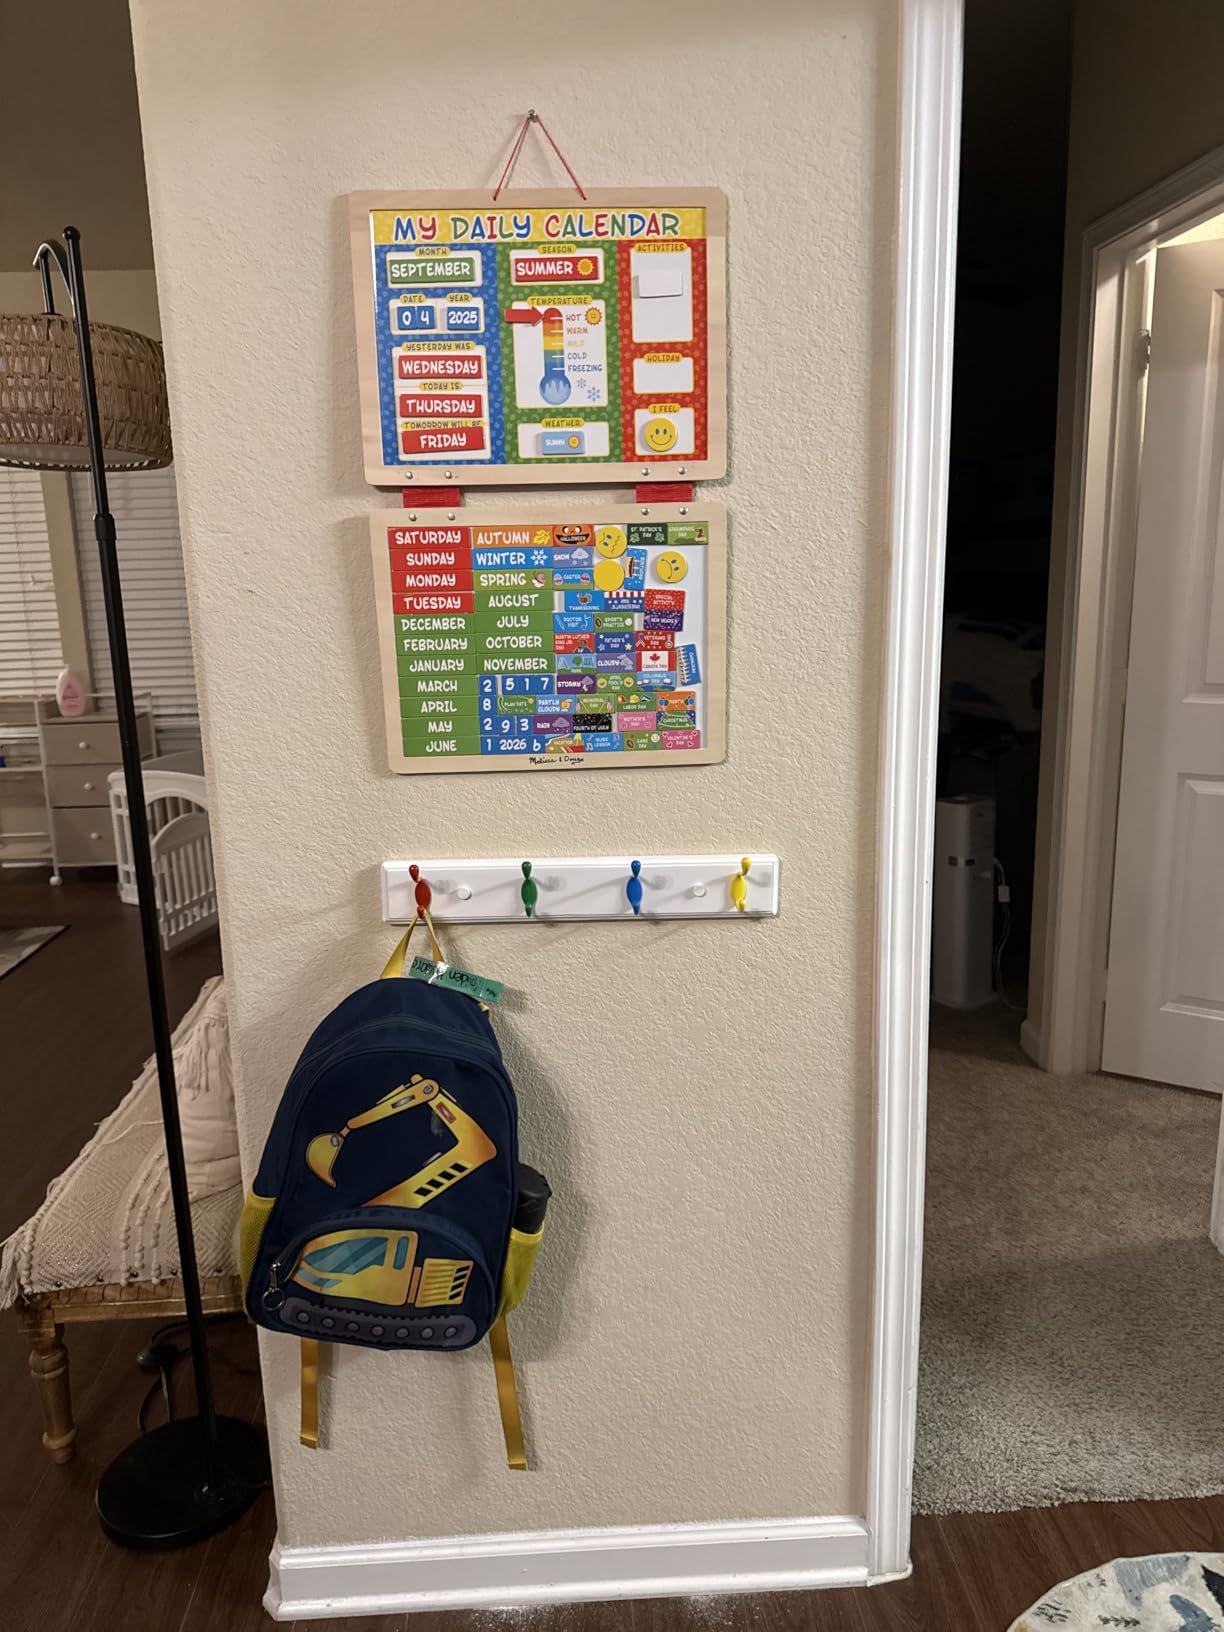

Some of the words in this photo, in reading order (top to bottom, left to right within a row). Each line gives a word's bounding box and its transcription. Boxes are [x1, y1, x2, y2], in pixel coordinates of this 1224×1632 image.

[393, 216, 437, 241] MY
[450, 215, 531, 240] DAILY
[544, 213, 680, 239] CALENDAR
[418, 247, 447, 256] MONTH
[542, 246, 572, 254] SEASON
[637, 243, 685, 252] ACTIVITIES
[391, 262, 470, 277] SEPTEMBER
[516, 261, 573, 276] SUMMER
[403, 295, 423, 303] DATE
[449, 294, 469, 302] YEAR
[530, 297, 588, 305] TEMPERATURE
[448, 311, 478, 324] 2025
[566, 313, 582, 321] HOT
[406, 343, 452, 351] YESTERDAY
[455, 342, 471, 350] WAS
[567, 352, 587, 360] COLD
[647, 354, 680, 362] HOLIDAY
[402, 360, 478, 374] WEDNESDAY
[568, 364, 603, 372] FREEZING
[451, 382, 460, 390] IS
[406, 399, 475, 413] THURSDAY
[652, 405, 657, 413] I
[659, 404, 678, 413] FEEL
[404, 421, 449, 429] TOMORROW
[544, 419, 581, 428] WEATHER
[420, 433, 467, 448] FRIDAY
[395, 531, 461, 544] SATURDAY
[477, 532, 529, 545] AUTUMN
[406, 552, 455, 566] SUNDAY
[476, 552, 526, 565] WINTER
[406, 574, 456, 587] MONDAY
[479, 573, 527, 586] SPRING
[404, 597, 461, 610] TUESDAY
[488, 594, 539, 608] AUGUST
[401, 617, 466, 631] DECEMBER
[496, 615, 529, 628] JULY
[403, 638, 468, 651] FEBRUARY
[485, 636, 542, 649] OCTOBER
[409, 659, 464, 672] JANUARY
[484, 658, 547, 671] NOVEMBER
[597, 659, 620, 667] CLOUDY
[417, 679, 458, 692] MARCH
[482, 680, 493, 693] 2
[505, 678, 515, 691] 5
[523, 678, 530, 691] 1
[540, 678, 550, 691] 7
[421, 701, 457, 713] APRIL
[482, 699, 492, 712] 8
[428, 721, 453, 733] MAY
[483, 718, 493, 731] 2
[501, 720, 511, 733] 9
[520, 718, 530, 731] 3
[425, 740, 457, 752] JUNE
[486, 739, 492, 752] 1
[499, 739, 527, 751] 2026
